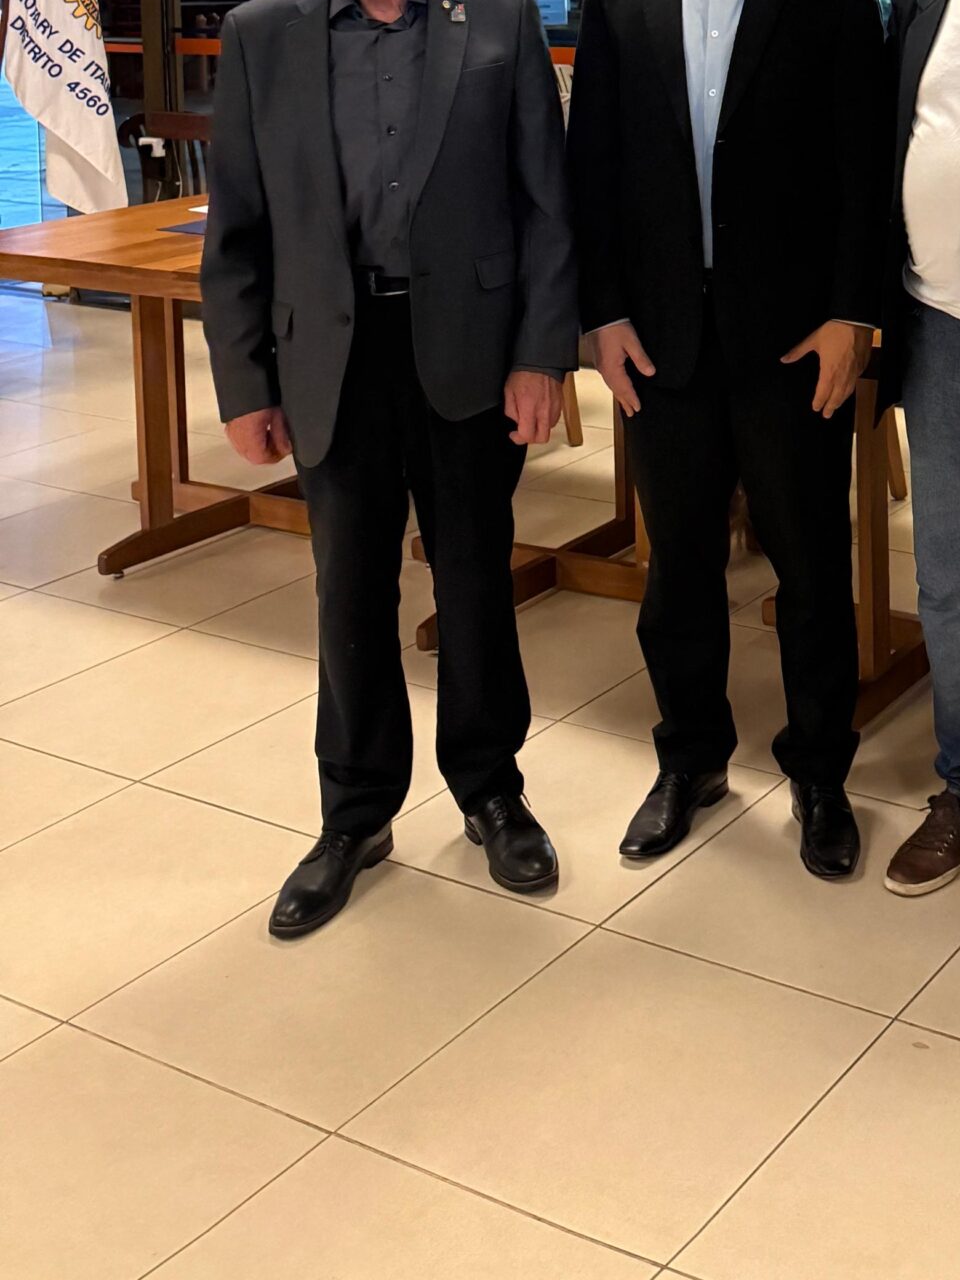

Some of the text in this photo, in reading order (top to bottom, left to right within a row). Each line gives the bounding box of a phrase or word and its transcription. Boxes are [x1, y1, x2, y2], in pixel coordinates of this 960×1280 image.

[9, 15, 109, 116] DISTRITO 4560
[58, 39, 86, 63] DE
